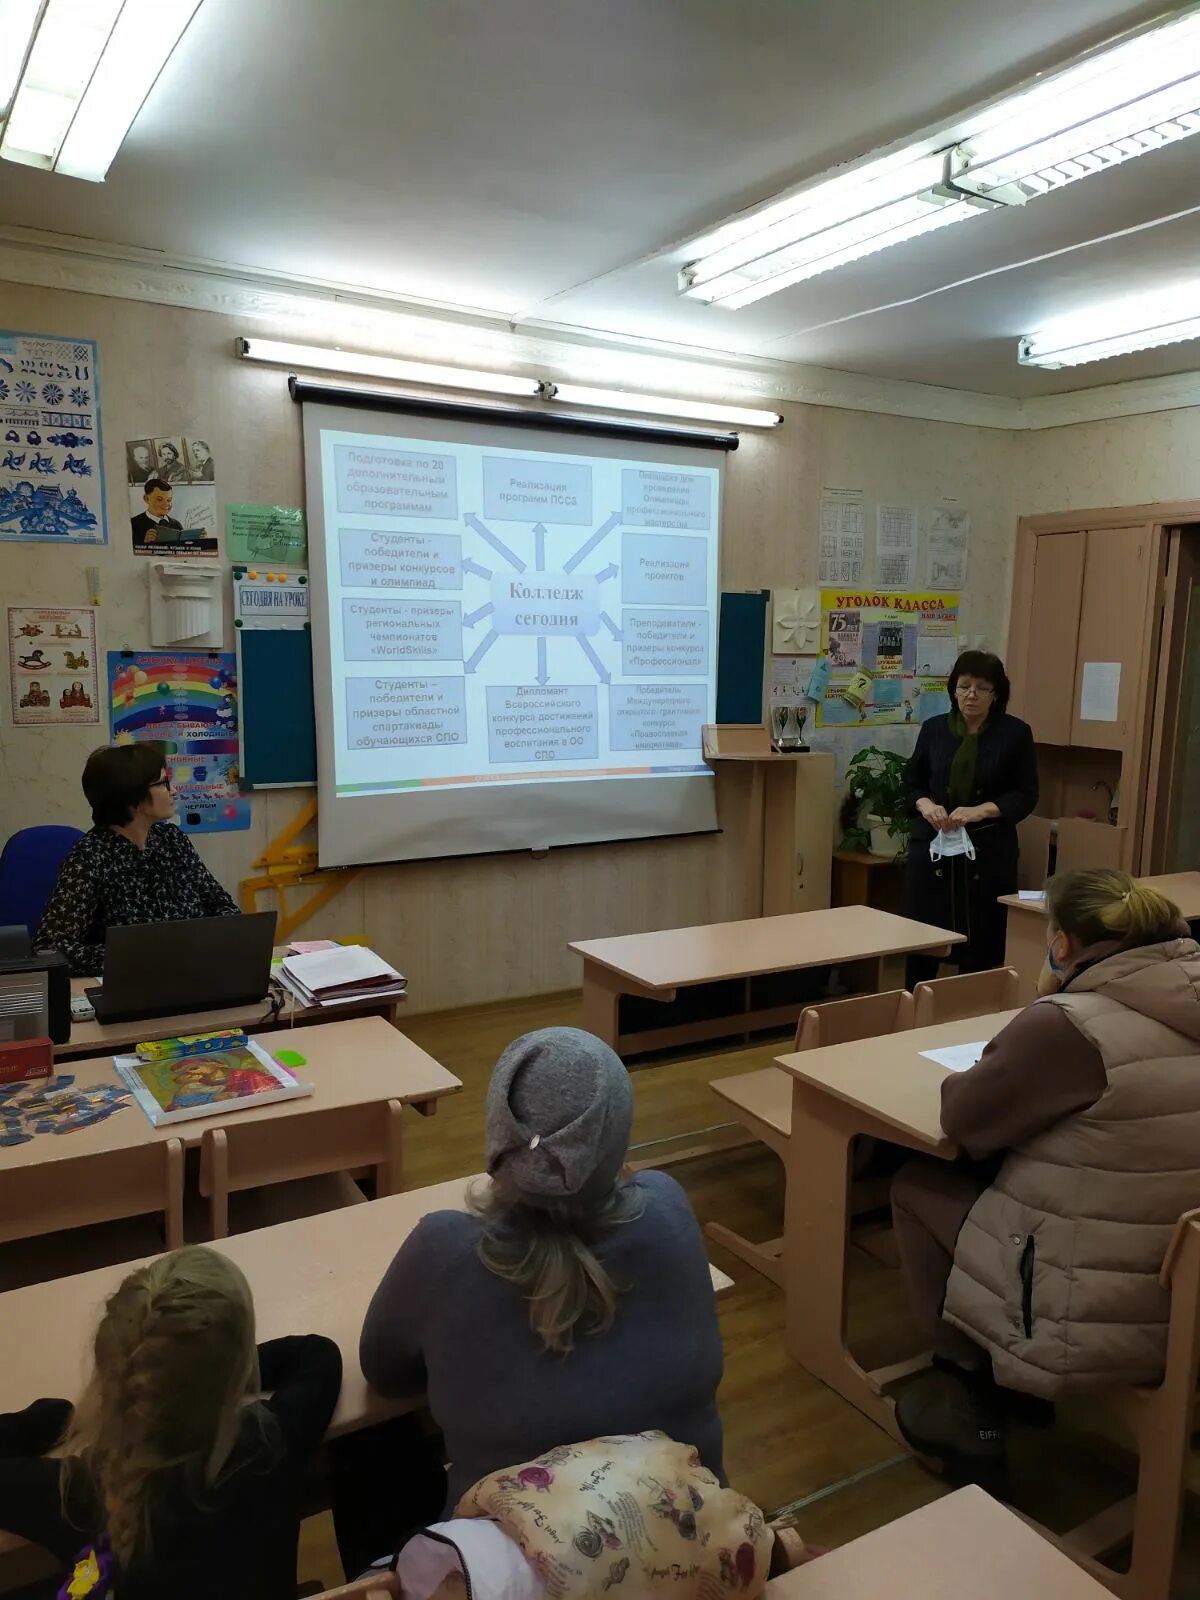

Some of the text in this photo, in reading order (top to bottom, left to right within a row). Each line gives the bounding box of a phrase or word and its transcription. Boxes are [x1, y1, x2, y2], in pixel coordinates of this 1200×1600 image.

[348, 452, 444, 470] Подготовка по 20
[347, 468, 446, 484] дополнительным
[346, 482, 448, 498] образовательным
[509, 478, 567, 492] Реализация
[499, 491, 577, 506] программ ПССЗ
[364, 500, 432, 512] программам
[371, 532, 425, 545] Студенты
[364, 546, 430, 559] победители
[348, 561, 456, 575] призеры конкурсов
[645, 570, 684, 581] проектов
[371, 577, 436, 588] и олимпиад
[509, 582, 584, 601] Колледж
[241, 590, 305, 607] СЕГОДНЯ НА УРОКЕ
[836, 596, 945, 611] УГОЛОК КЛАССА
[350, 605, 402, 615] Студенты
[411, 607, 454, 617] призеры
[366, 620, 440, 629] региональных
[514, 613, 578, 627] сегодня
[629, 618, 697, 629] Преподаватели
[831, 613, 847, 631] 75
[370, 633, 437, 642] чемпионатов
[636, 630, 687, 640] победители
[626, 644, 663, 655] призеры
[375, 680, 428, 691] Студенты
[369, 692, 434, 704] победители
[516, 687, 568, 697] Дипломант
[505, 699, 581, 710] Всероссийского
[353, 706, 460, 719] призеры областной
[492, 711, 593, 724] конкурса достижений
[372, 721, 444, 733] спартакиады
[642, 719, 676, 728] конкурса
[495, 725, 592, 736] профессионального
[356, 732, 459, 747] обучающихся СПО
[504, 739, 559, 749] воспитания
[570, 736, 584, 745] ОО
[535, 751, 555, 760] СПО
